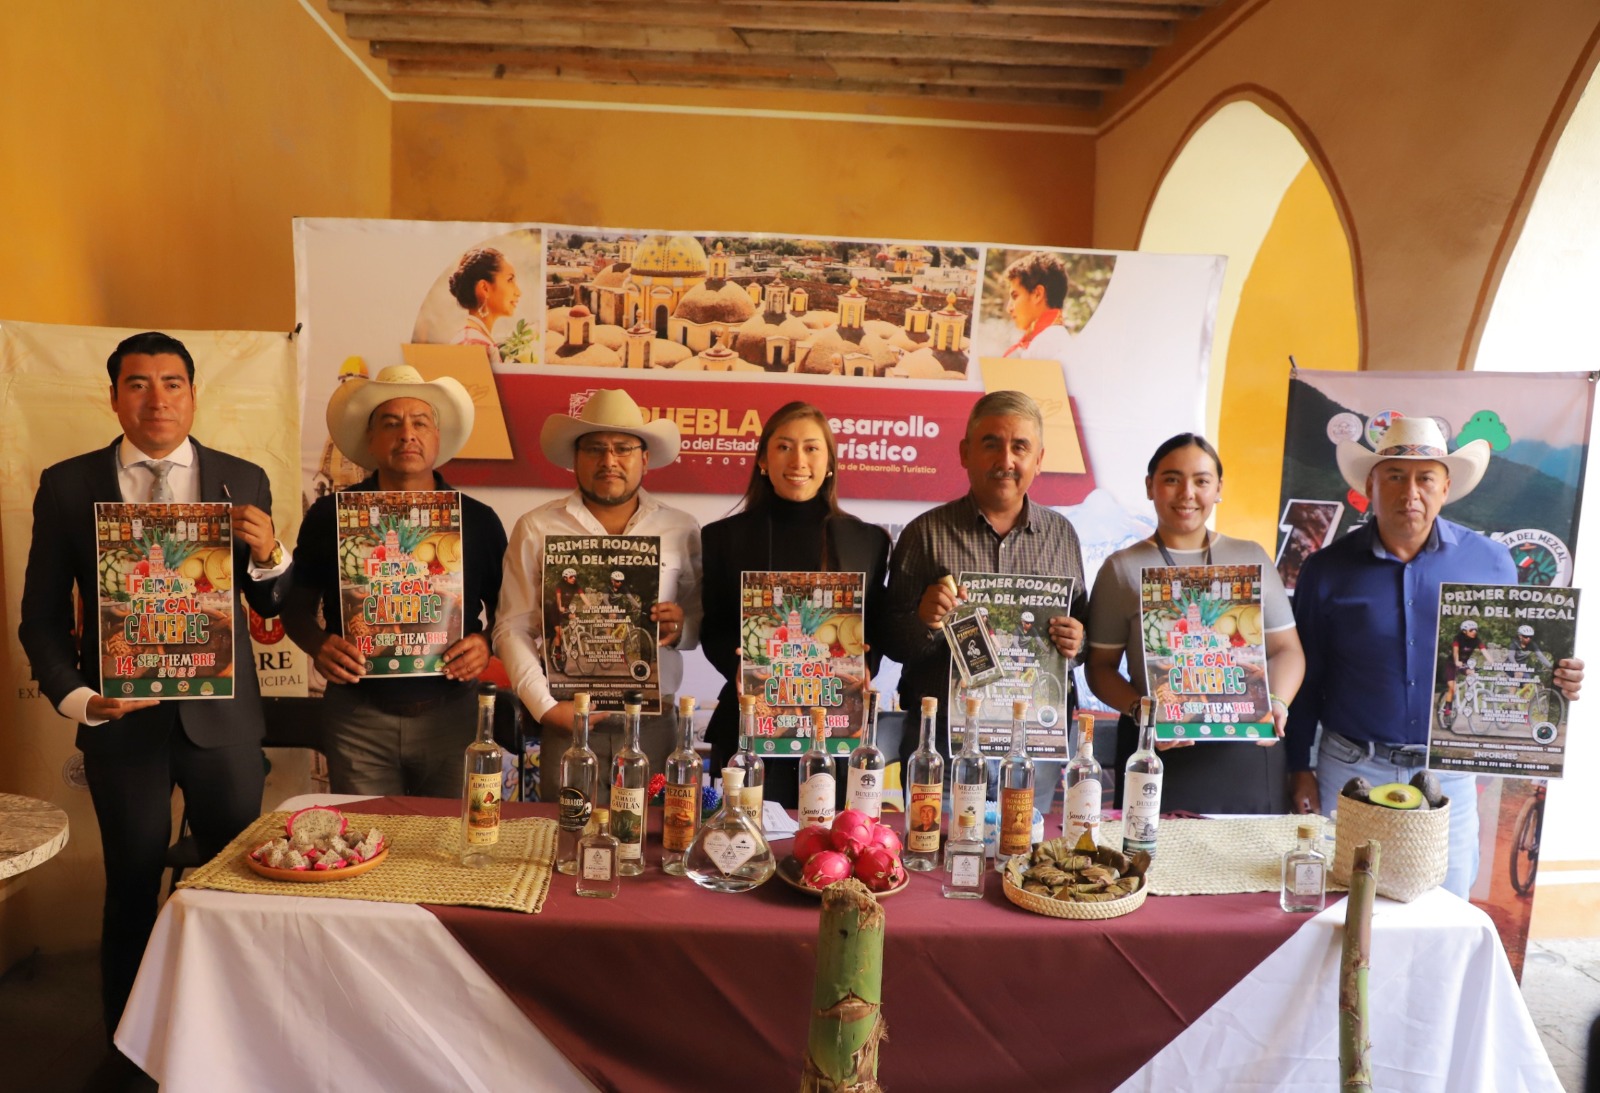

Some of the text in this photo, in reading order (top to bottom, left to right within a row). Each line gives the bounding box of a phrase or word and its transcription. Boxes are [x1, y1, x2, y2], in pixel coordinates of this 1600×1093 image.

[828, 415, 940, 438] esarrollo
[692, 438, 714, 450] del
[837, 438, 918, 462] rístico
[847, 463, 857, 471] de
[859, 463, 901, 472] Desarrollo
[902, 465, 937, 474] Turístico
[548, 539, 658, 555] PRIMER RODADA
[1516, 532, 1536, 541] DEL
[1538, 534, 1568, 563] MEZCAL
[546, 555, 658, 566] RUTA DEL MEZCAL
[371, 561, 417, 576] FERIA
[132, 577, 184, 593] FERIA
[370, 581, 434, 596] MEZCAL
[963, 578, 1068, 597] PRIMER RODADA
[131, 598, 201, 614] MEZCAL
[994, 593, 1017, 604] DEL
[1019, 595, 1067, 608] MEZCAL
[1445, 589, 1575, 608] PRIMER RODADA
[363, 594, 443, 625] CALTEPEC
[1442, 605, 1575, 620] RUTA DEL MEZCAL
[124, 614, 210, 644] CALTEPEC
[357, 631, 448, 655] 14 SEPTIEMBRE
[1174, 635, 1219, 649] FERIA
[395, 645, 431, 656] 2025
[775, 644, 818, 657] FERIA
[115, 653, 216, 676] 14 SEPTIEMBRE
[1173, 653, 1237, 667] MEZCAL
[158, 667, 197, 678] 2025
[772, 664, 834, 677] MEZCAL
[1169, 667, 1246, 695] CALTEPEC
[765, 678, 843, 706] CALTEPEC
[1164, 702, 1255, 721] 14 SEPTIEMBRE
[1204, 713, 1239, 723] 2025
[757, 717, 775, 735] 14
[802, 807, 819, 816] Santo
[1067, 811, 1086, 820] Santo
